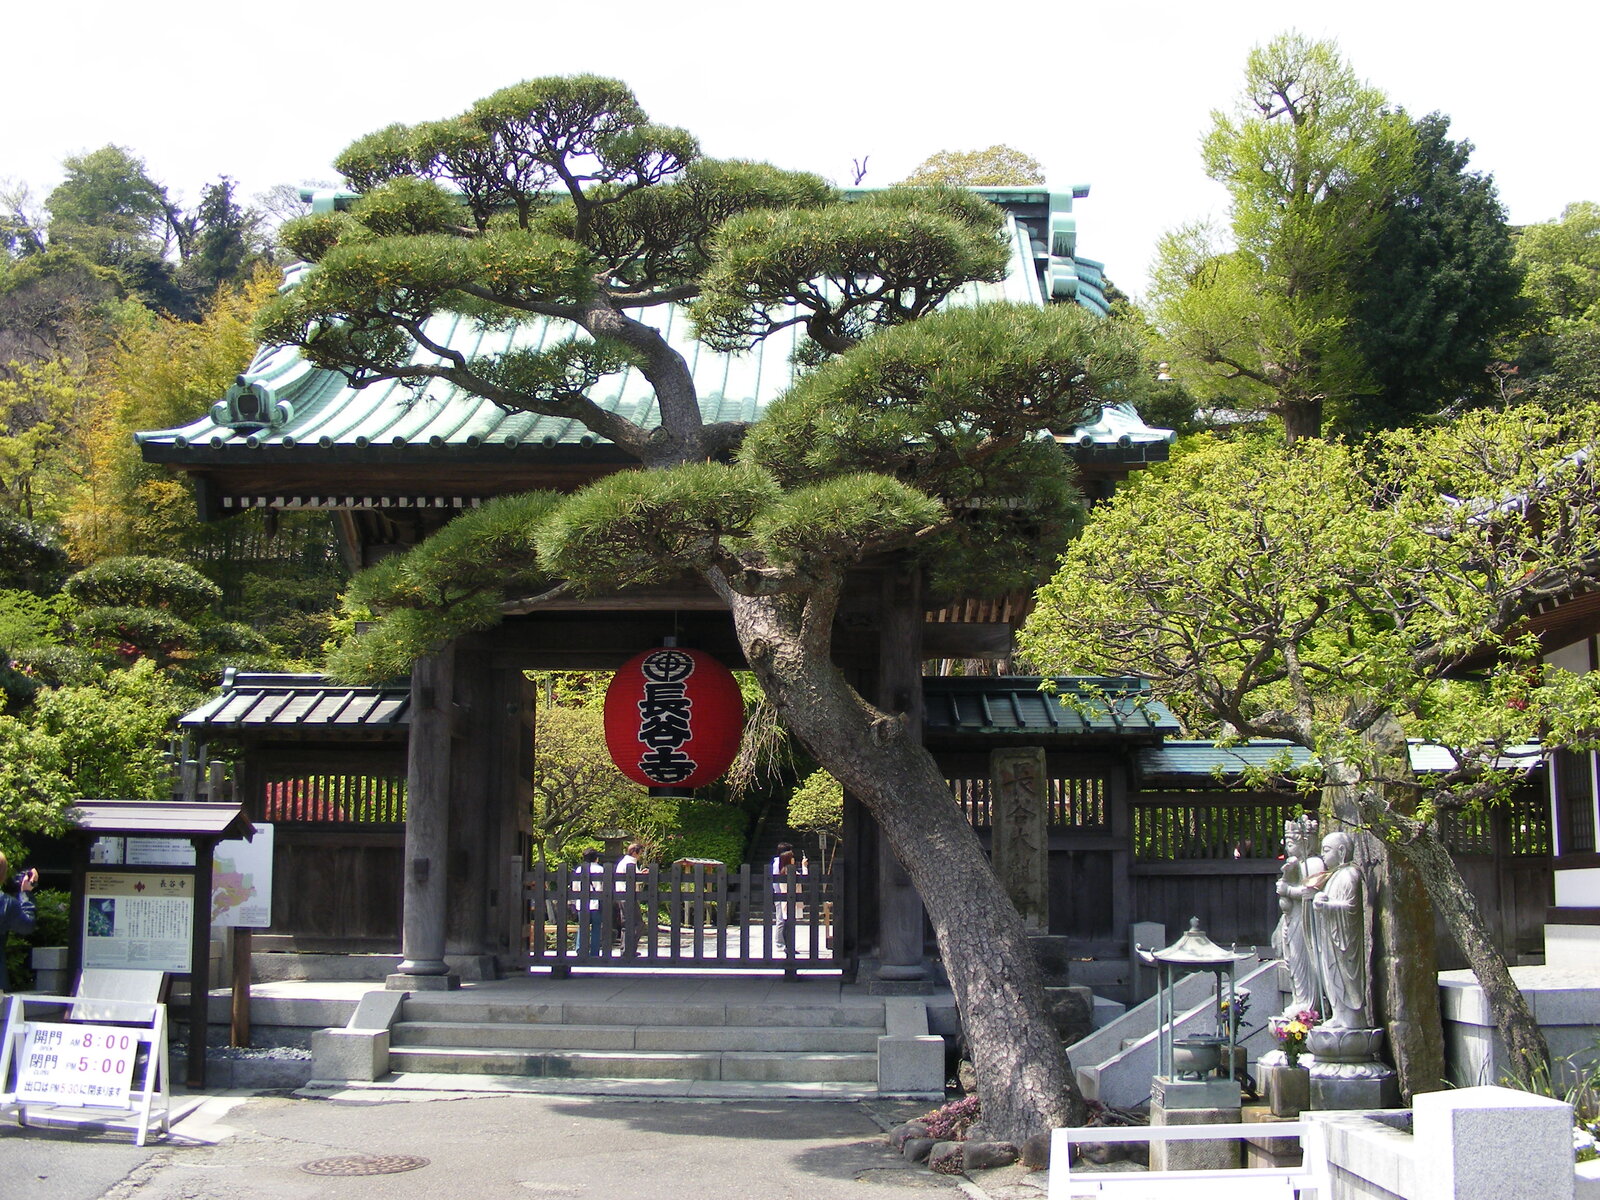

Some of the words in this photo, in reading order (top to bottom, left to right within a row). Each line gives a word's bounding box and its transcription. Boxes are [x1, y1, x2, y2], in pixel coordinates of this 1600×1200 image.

[637, 681, 698, 784] 長谷寺
[160, 879, 186, 888] 長谷寺
[33, 1029, 63, 1046] 開門
[82, 1033, 129, 1050] 8:00
[29, 1053, 59, 1070] 閉門
[66, 1062, 77, 1070] PM
[78, 1057, 126, 1074] 5:00
